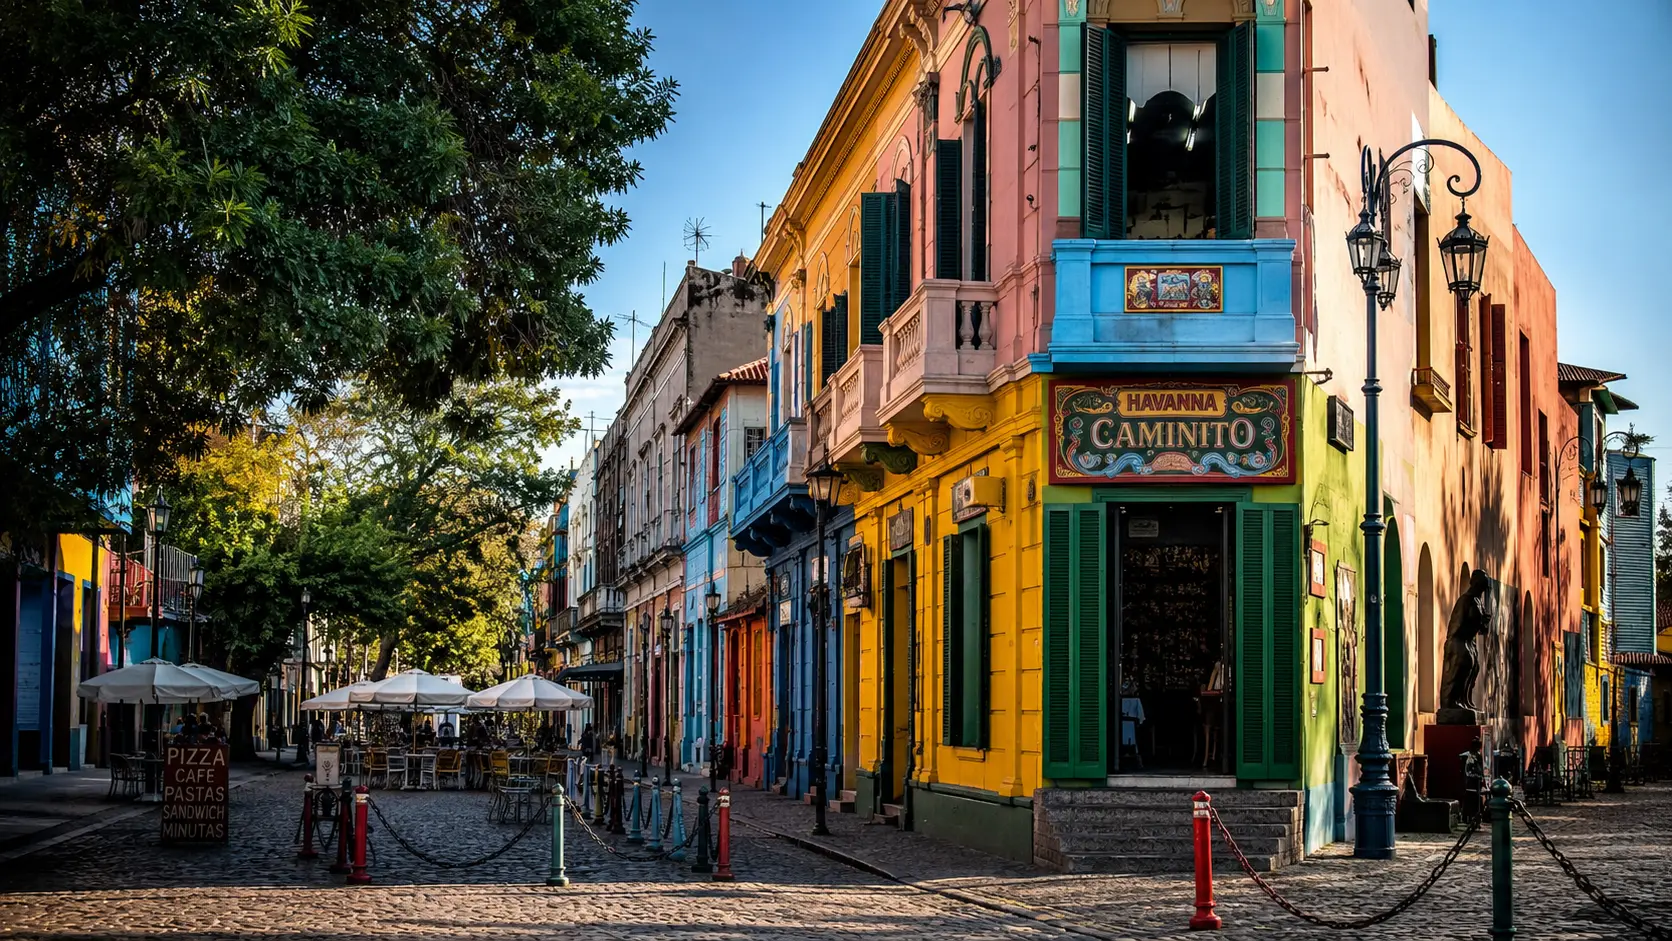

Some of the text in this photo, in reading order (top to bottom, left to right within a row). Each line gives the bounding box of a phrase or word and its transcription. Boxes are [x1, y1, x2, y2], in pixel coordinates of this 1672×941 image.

[1127, 393, 1219, 412] HAVANNA
[1090, 417, 1256, 449] CAMINITO
[167, 747, 225, 766] PIZZA
[175, 768, 215, 783] CAFE
[164, 786, 224, 802] PASTAS
[163, 804, 225, 820] SANDWICH
[162, 823, 224, 838] MINUTAS
